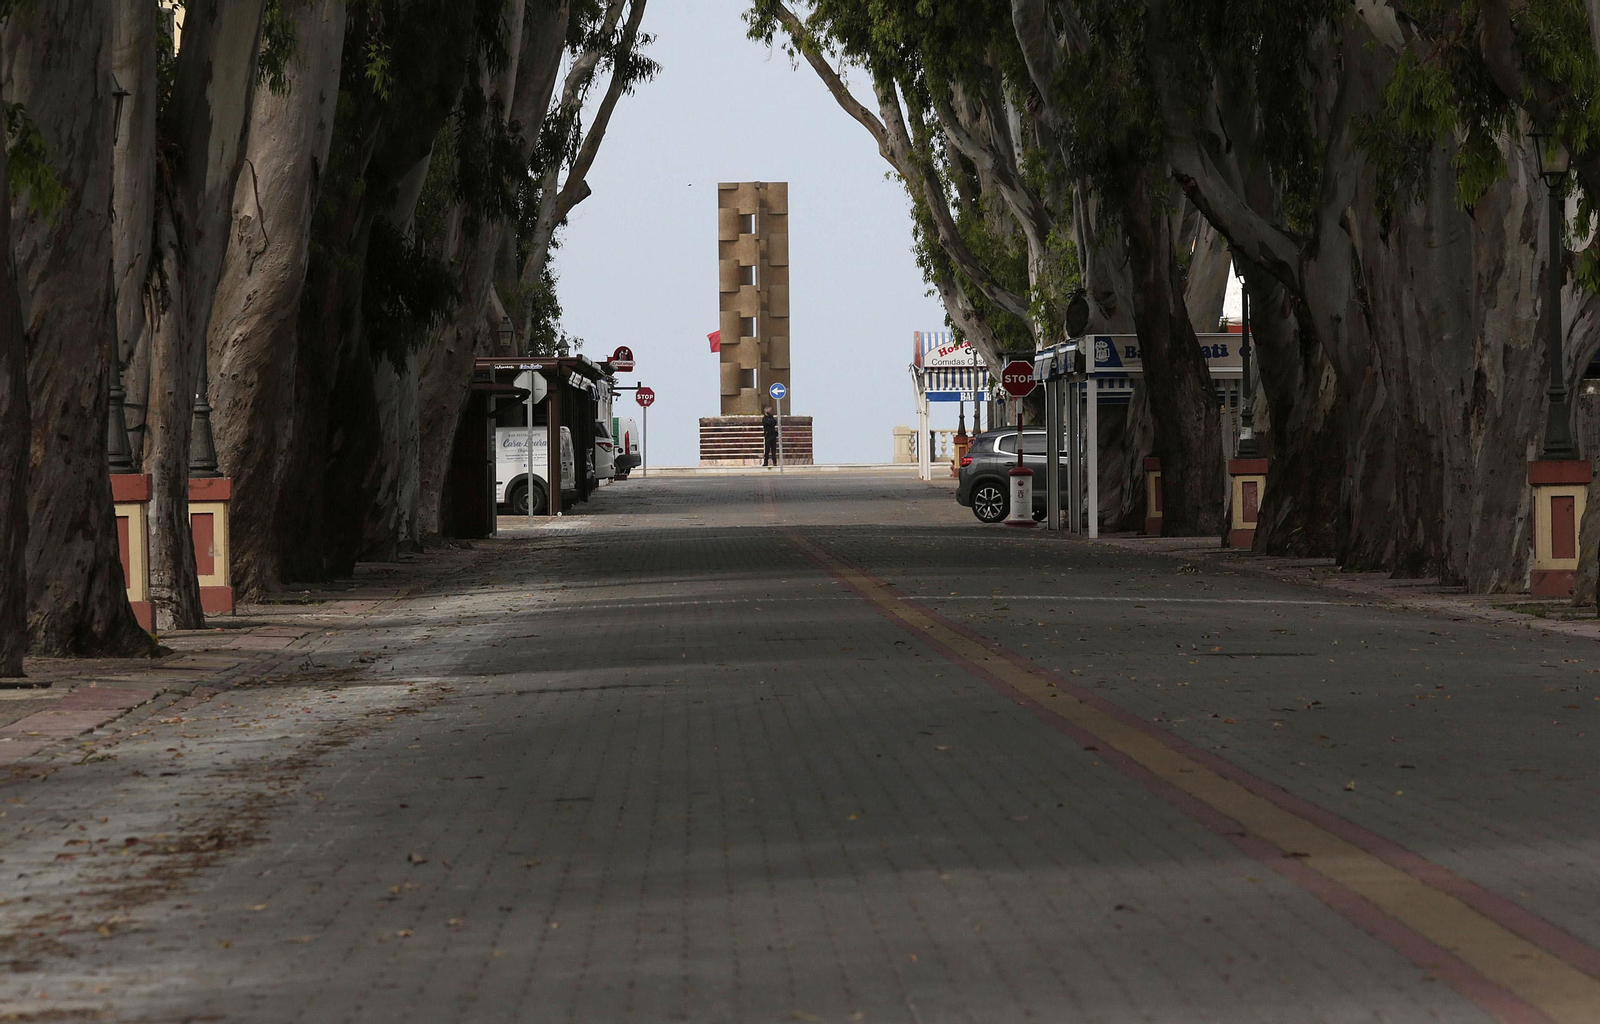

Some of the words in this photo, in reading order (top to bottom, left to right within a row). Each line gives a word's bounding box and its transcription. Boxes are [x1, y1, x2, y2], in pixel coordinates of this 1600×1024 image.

[938, 340, 971, 357] Hosta
[1201, 343, 1229, 358] ati
[931, 358, 965, 366] Comidas
[1004, 375, 1033, 383] STOP
[523, 438, 547, 448] Lura
